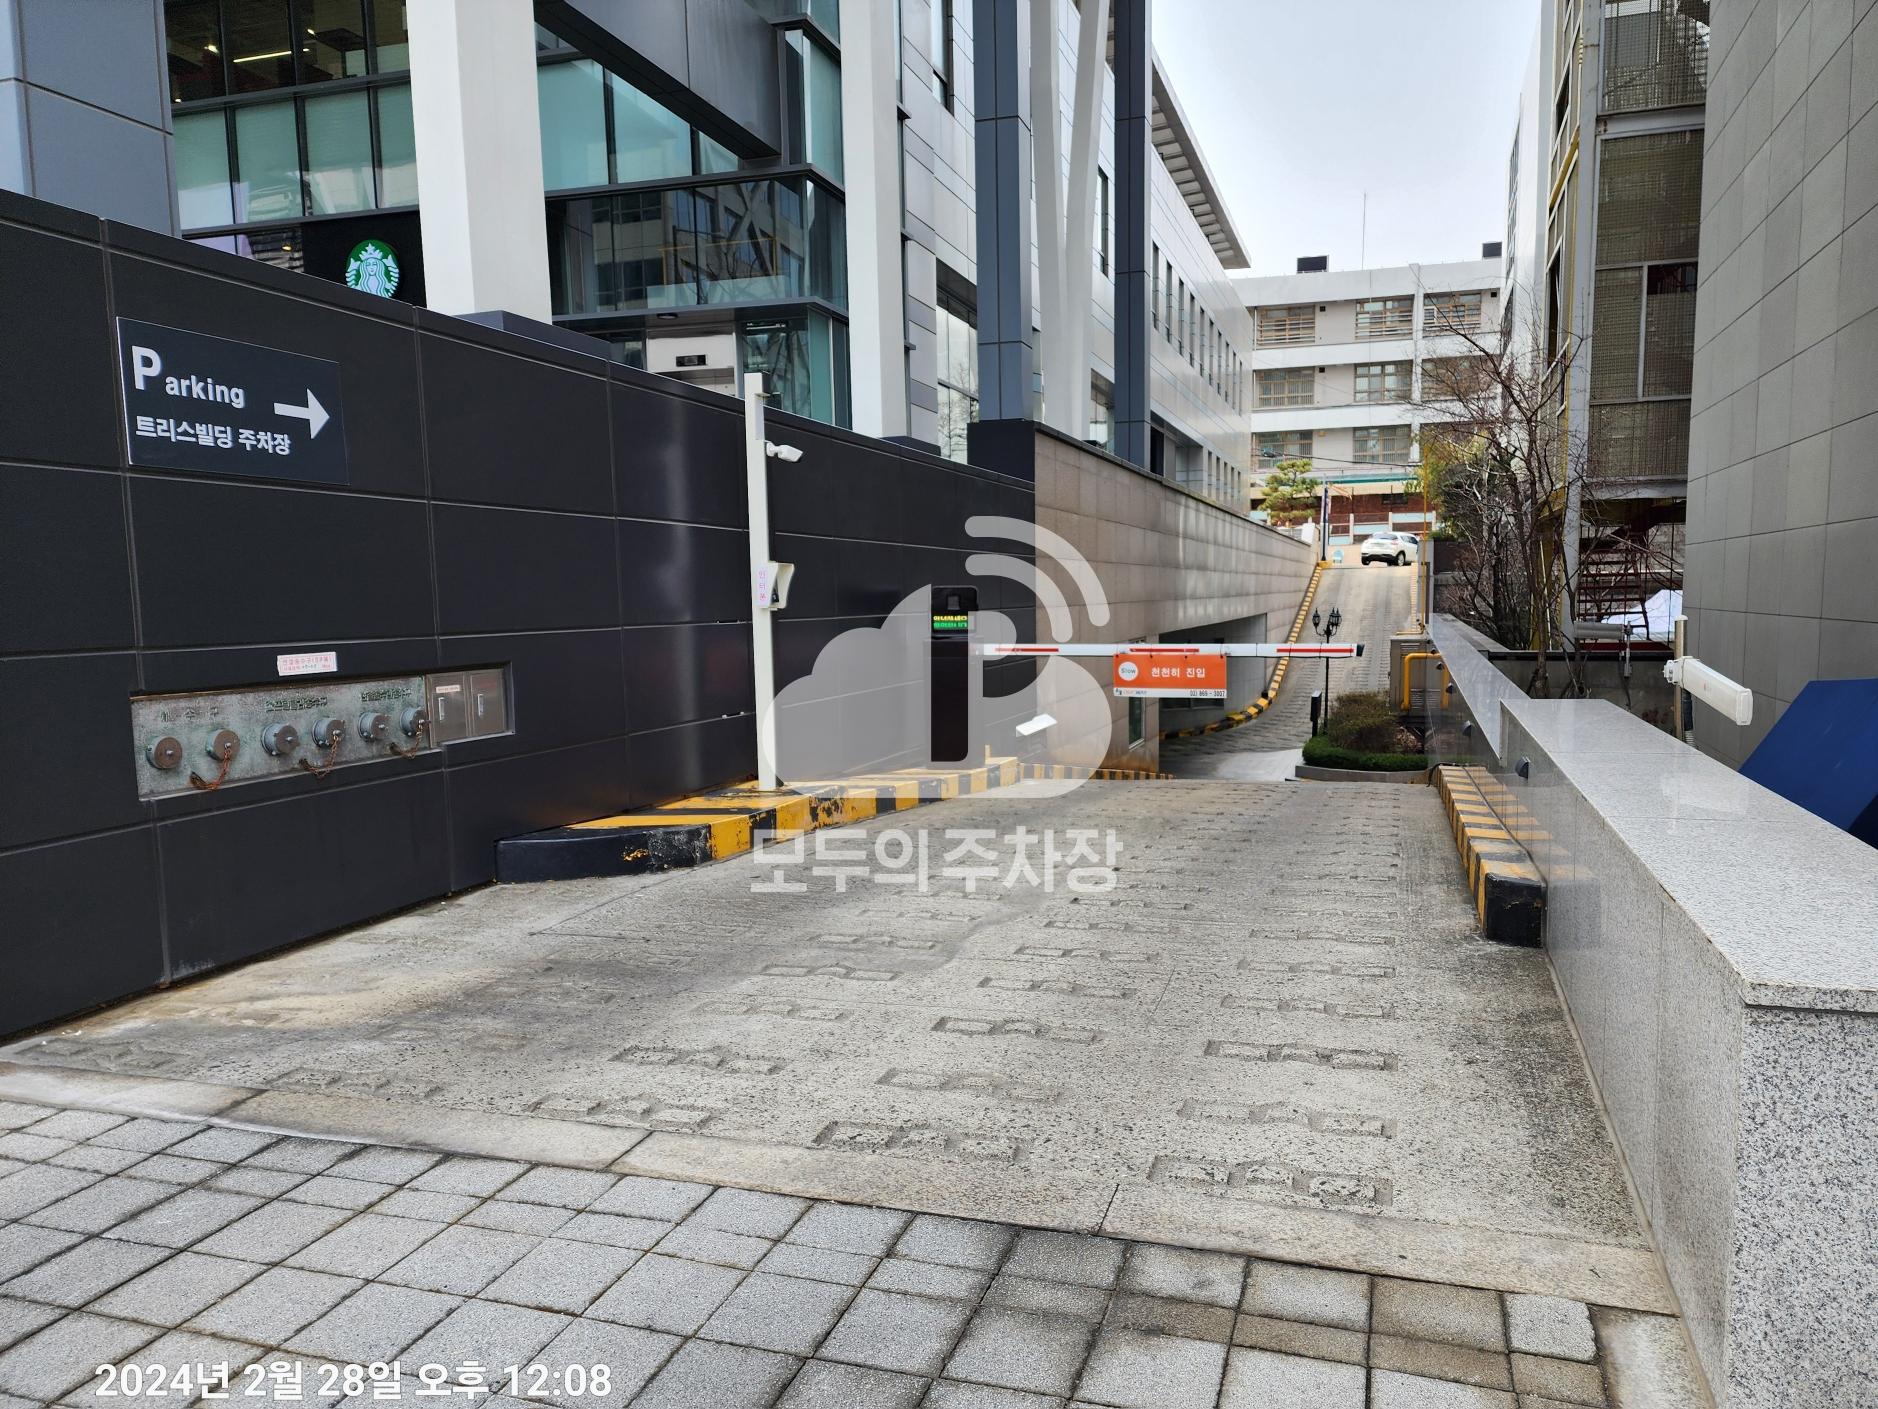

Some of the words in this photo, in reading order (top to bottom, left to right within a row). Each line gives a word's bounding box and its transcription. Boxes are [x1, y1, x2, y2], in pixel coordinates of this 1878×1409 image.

[132, 346, 245, 409] Parking
[136, 416, 233, 449] 트리스빌딩
[238, 429, 291, 455] 주차장
[1151, 667, 1180, 678] 천천히
[1186, 667, 1206, 678] 진입
